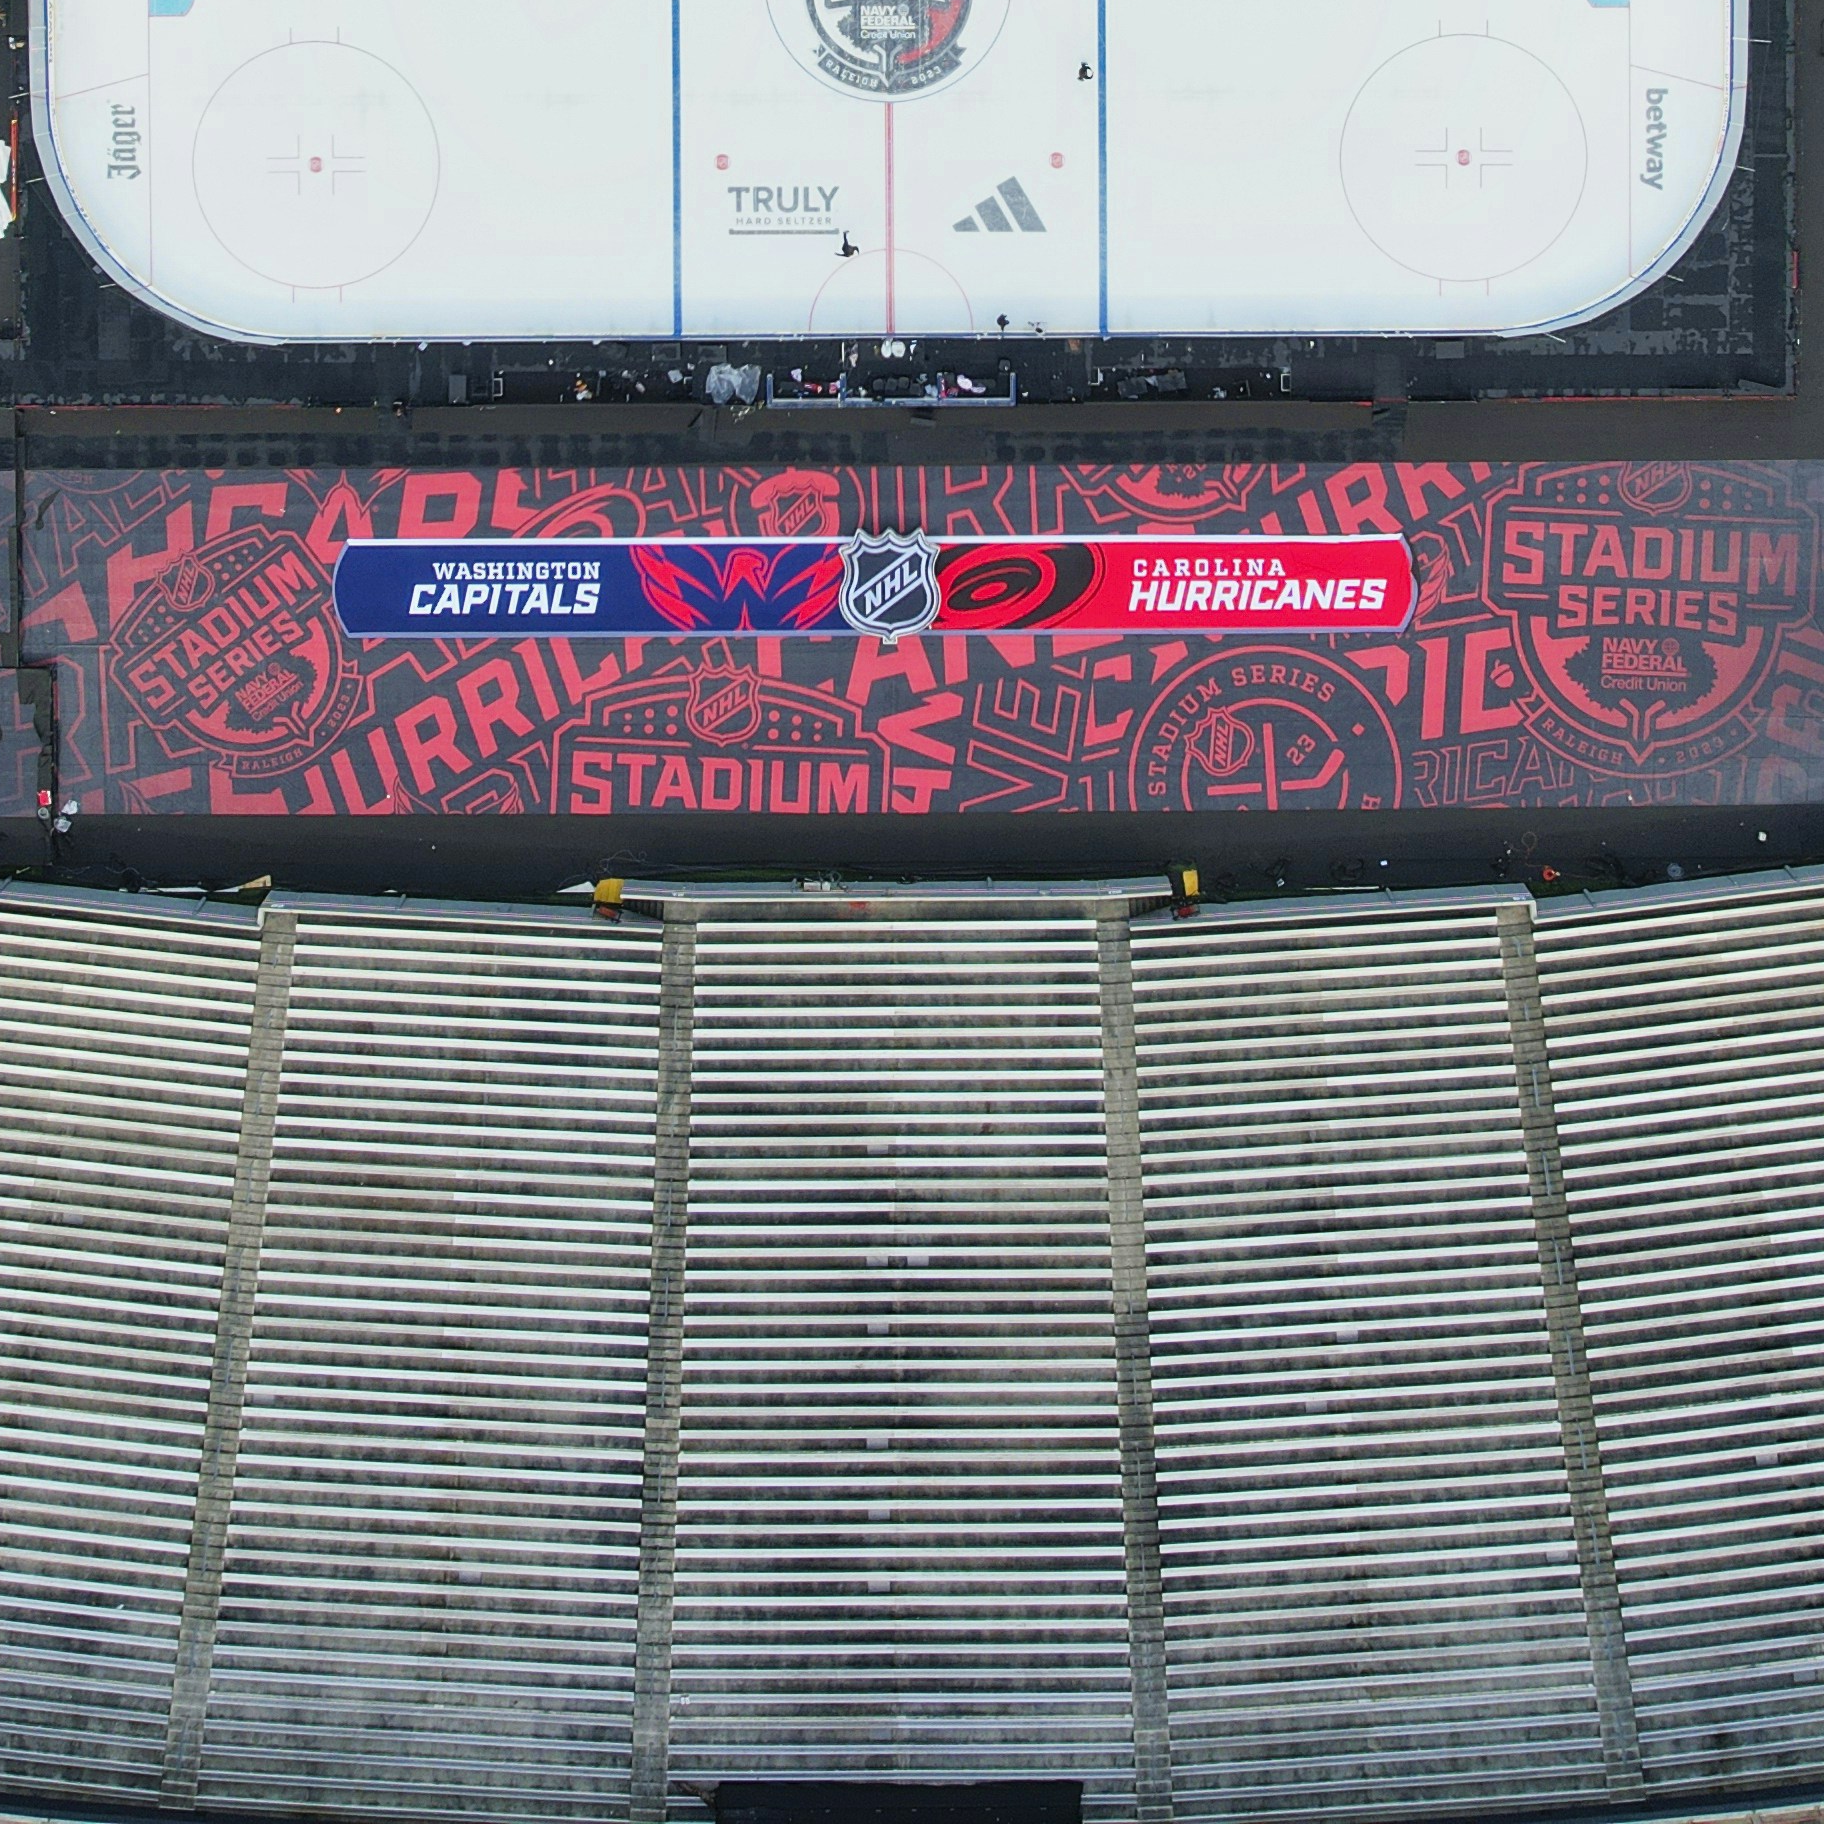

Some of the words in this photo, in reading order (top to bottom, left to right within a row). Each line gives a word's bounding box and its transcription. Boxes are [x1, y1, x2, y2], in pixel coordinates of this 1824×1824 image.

[860, 5, 897, 16] NAVY
[860, 15, 915, 26] FEDERAL
[889, 29, 916, 40] Union
[1639, 87, 1669, 192] betway
[727, 185, 840, 214] TRULY
[735, 216, 771, 226] HARD
[778, 216, 833, 226] SELTZER
[783, 495, 816, 536] NHL
[433, 561, 601, 580] WASHINGTON
[1133, 559, 1286, 577] CAROLINA
[1502, 519, 1800, 596] STADIUM
[176, 562, 198, 604] NHL
[408, 582, 601, 615] CAPITALS
[863, 560, 918, 616] NHL
[1128, 578, 1388, 612] HURRICANES
[1557, 583, 1740, 636] SERIES
[127, 552, 318, 711] STADIUM
[1602, 637, 1659, 653] NAVY
[185, 610, 305, 711] SERIES
[1601, 653, 1688, 673] FEDERAL
[234, 671, 268, 701] NAVY
[240, 669, 298, 710] FEDERAL
[1600, 675, 1644, 693] Credit
[1647, 677, 1687, 694] Union
[701, 688, 746, 727] NHL
[1147, 677, 1223, 796] STADIUM
[1231, 663, 1336, 703] SERIES
[1212, 722, 1229, 767] NHL
[1541, 717, 1624, 766] RALEIGH
[1675, 734, 1724, 763] 2023
[241, 747, 304, 772] RALEIGH
[1285, 733, 1316, 766] 23
[571, 749, 869, 815] STADIUM
